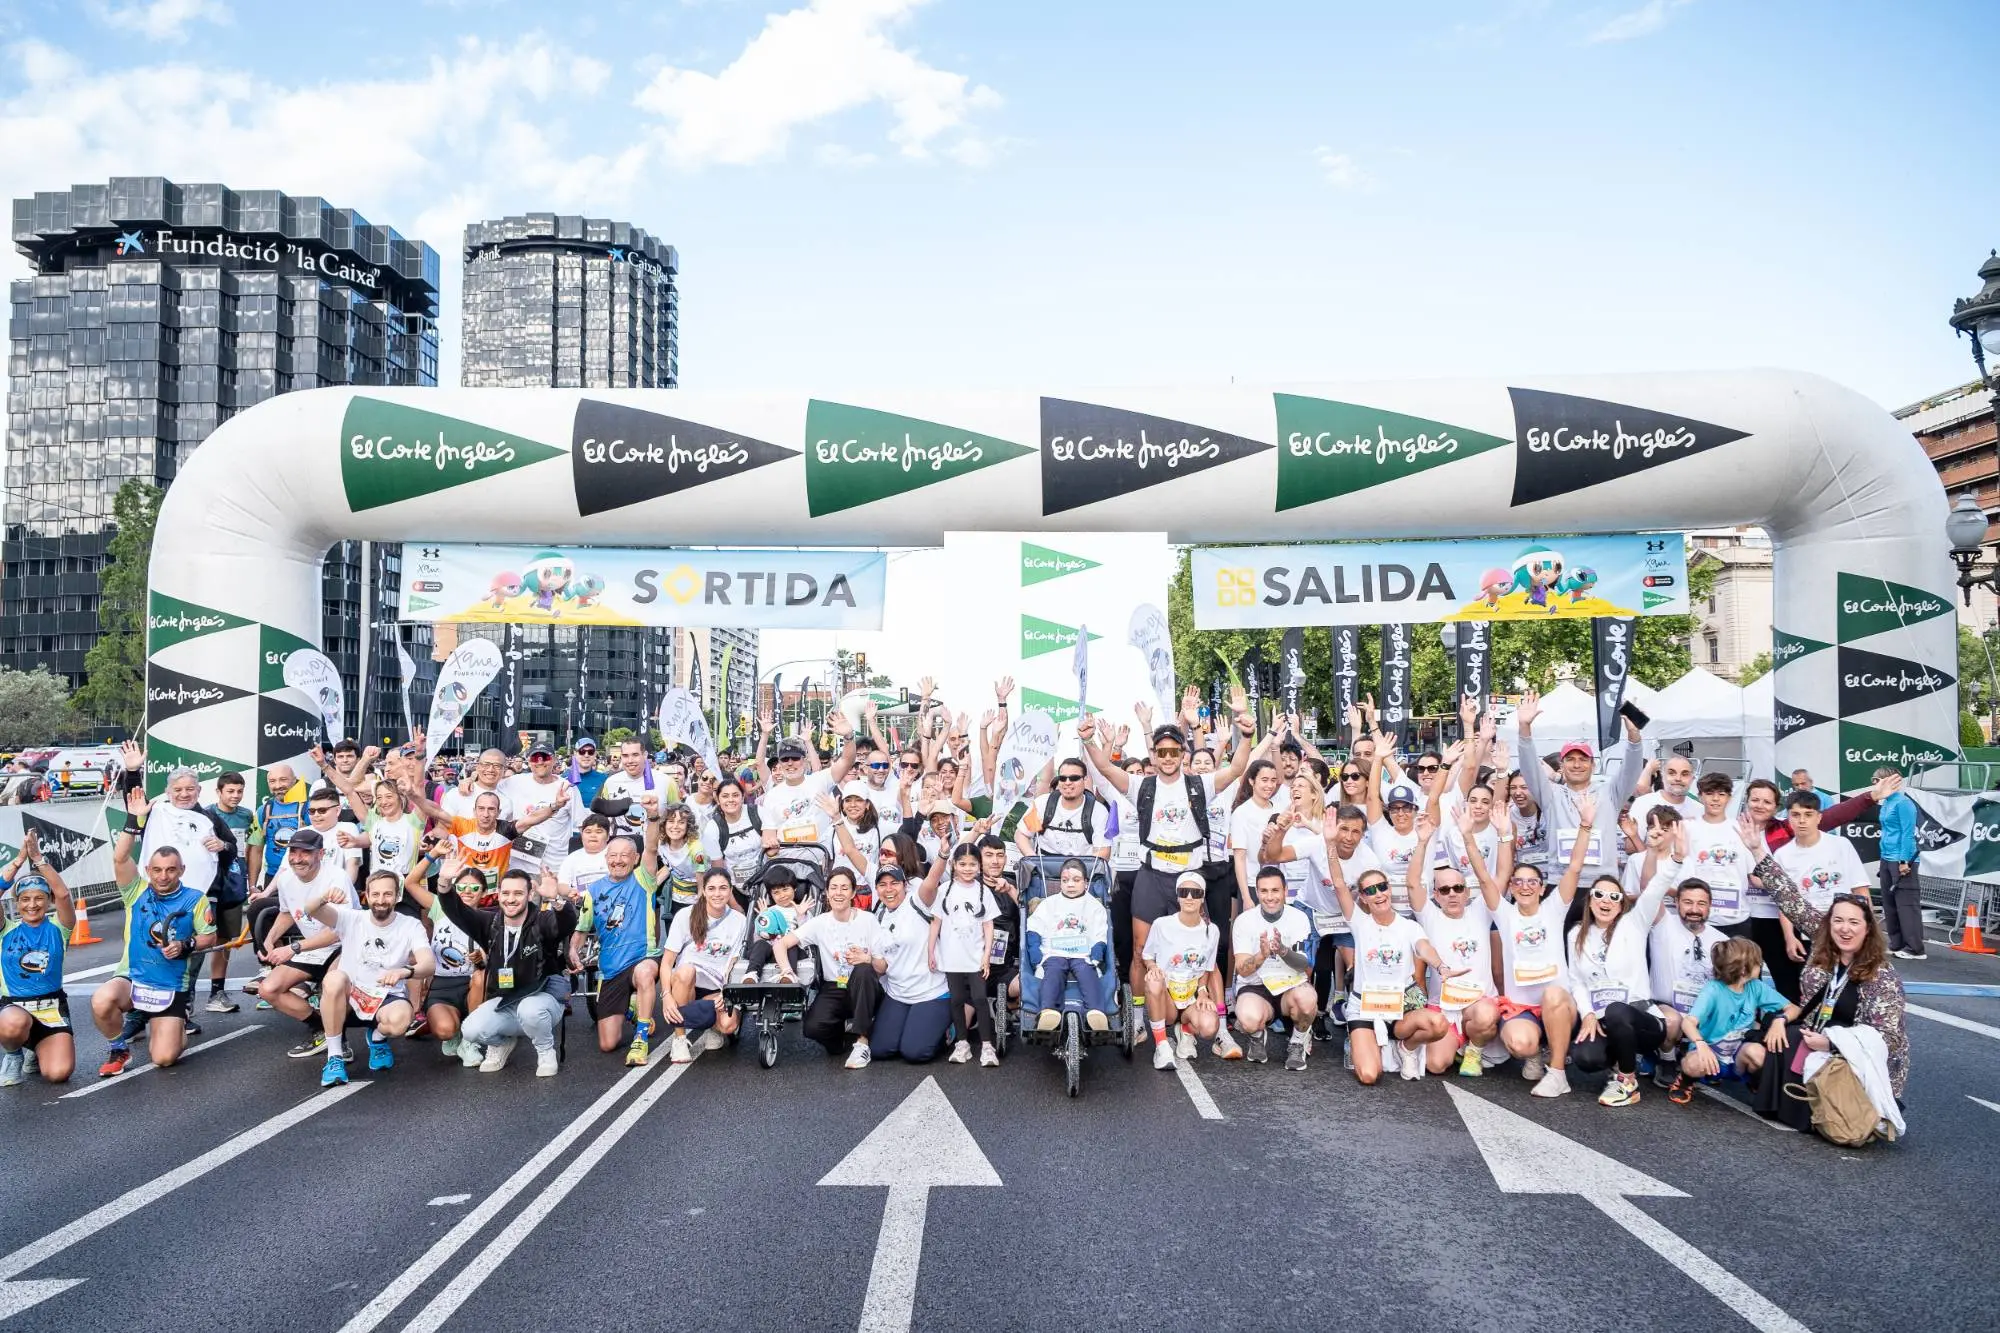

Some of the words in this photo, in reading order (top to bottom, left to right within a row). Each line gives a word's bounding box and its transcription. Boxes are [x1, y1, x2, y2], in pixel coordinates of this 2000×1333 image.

[156, 230, 280, 263] Fundació
[351, 435, 372, 460] El
[377, 436, 432, 460] Corte
[436, 431, 515, 470] Inglés
[583, 438, 606, 463] El
[609, 440, 664, 465] Corte
[668, 434, 749, 473] Inglés
[816, 439, 839, 463] El
[842, 439, 898, 463] Corte
[902, 433, 983, 473] Inglés
[1052, 436, 1073, 460] El
[1077, 437, 1134, 462] Corte
[1138, 430, 1220, 469] Inglés
[1289, 432, 1312, 457] El
[1315, 433, 1372, 457] Corte
[1376, 425, 1458, 465] Inglés
[1527, 427, 1551, 453] El
[1553, 428, 1609, 452] Corte
[1613, 420, 1696, 459] Inglés
[1262, 563, 1457, 607] SALIDA
[157, 614, 176, 628] Corte
[178, 611, 225, 632] Inglés
[1845, 600, 1858, 614] El
[1861, 599, 1897, 613] Corte
[1900, 595, 1941, 616] Inglés
[266, 651, 279, 664] El
[1336, 629, 1358, 677] Inglés
[1604, 623, 1627, 681] Corte
[155, 688, 176, 700] Corte
[178, 684, 224, 704] Inglés
[1388, 668, 1403, 707] Corte
[1464, 653, 1483, 697] Corte
[1845, 674, 1858, 688] El
[1861, 674, 1898, 687] Corte
[1900, 670, 1942, 691] Inglés
[264, 723, 277, 737] El
[278, 724, 303, 737] Corte
[1846, 748, 1860, 762] El
[1863, 749, 1899, 762] Corte
[1901, 745, 1943, 767] Inglés
[524, 841, 534, 851] 9
[1847, 823, 1862, 838] El
